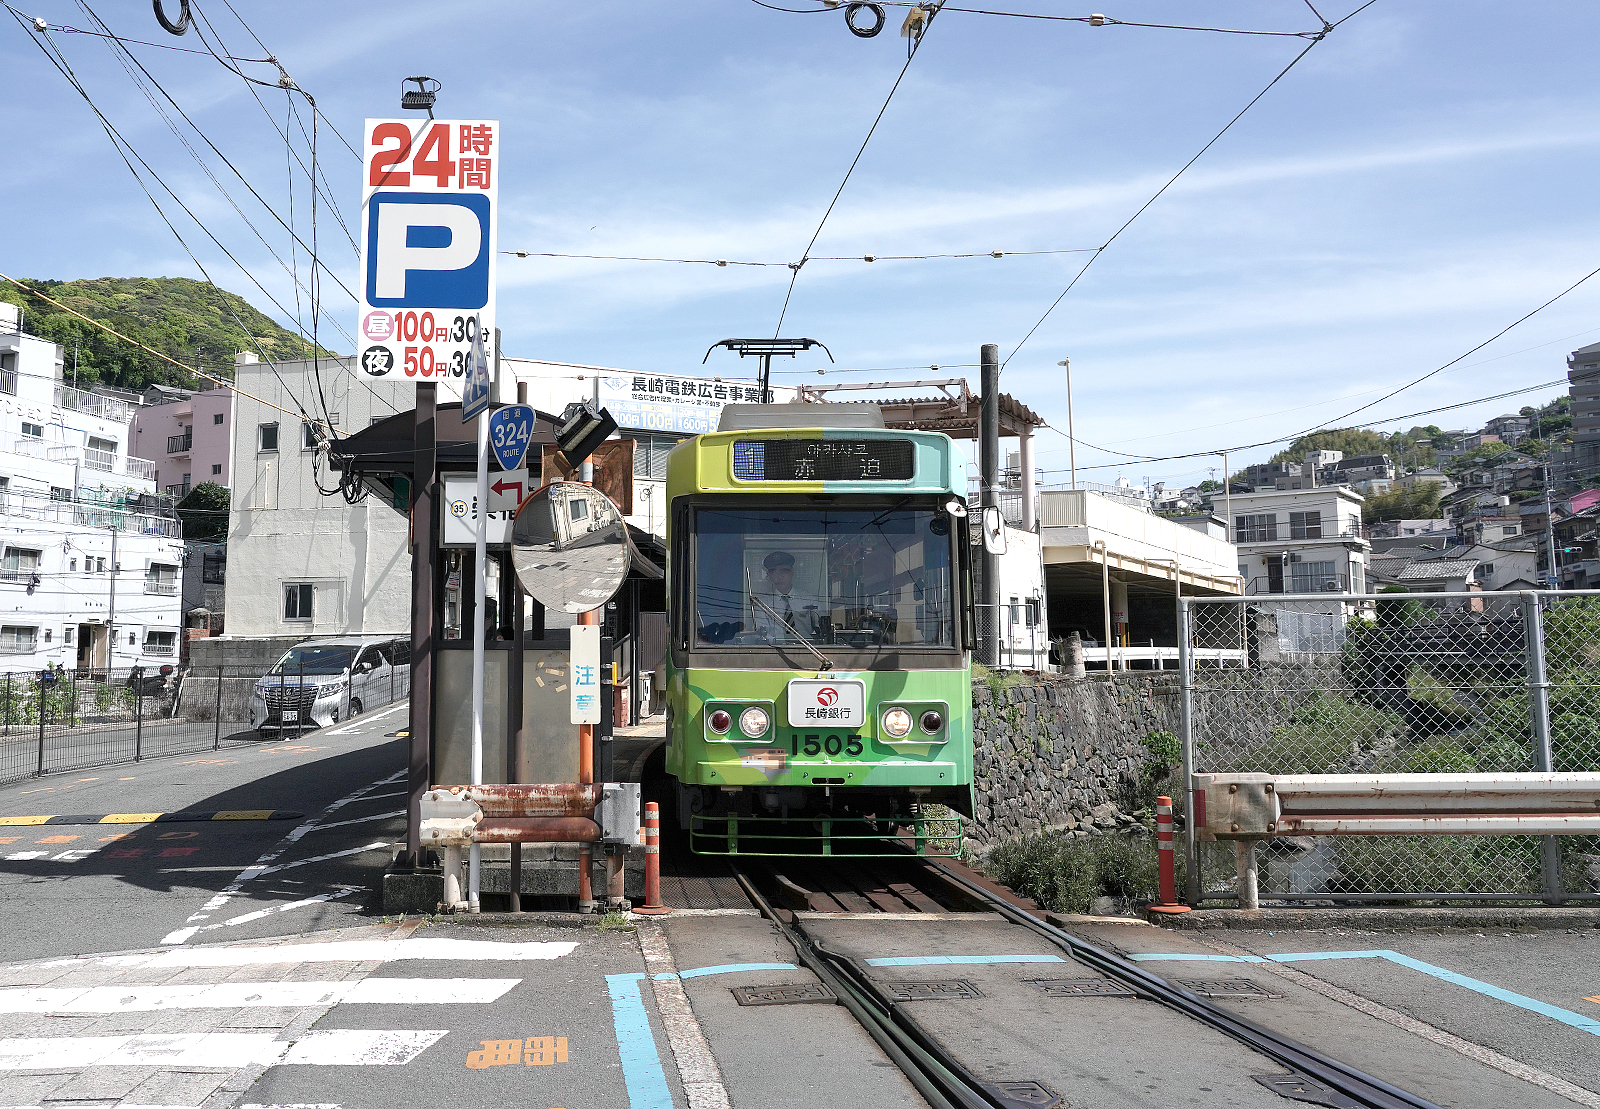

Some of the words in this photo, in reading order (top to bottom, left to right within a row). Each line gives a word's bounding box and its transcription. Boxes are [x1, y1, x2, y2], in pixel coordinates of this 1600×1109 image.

[369, 122, 456, 188] 24
[458, 124, 493, 190] 時間
[375, 202, 482, 299] P
[366, 315, 391, 337] 昼
[364, 349, 391, 373] 夜
[631, 376, 775, 405] 長崎電鉄広告事業部
[502, 408, 521, 421] 国道
[640, 411, 674, 430] 100円
[494, 420, 529, 448] 324
[502, 448, 520, 458] ROUTE
[744, 447, 754, 474] 1
[453, 504, 464, 514] 35
[575, 664, 596, 716] 注意
[804, 707, 852, 720] 長崎銀行
[791, 734, 864, 757] 1505
